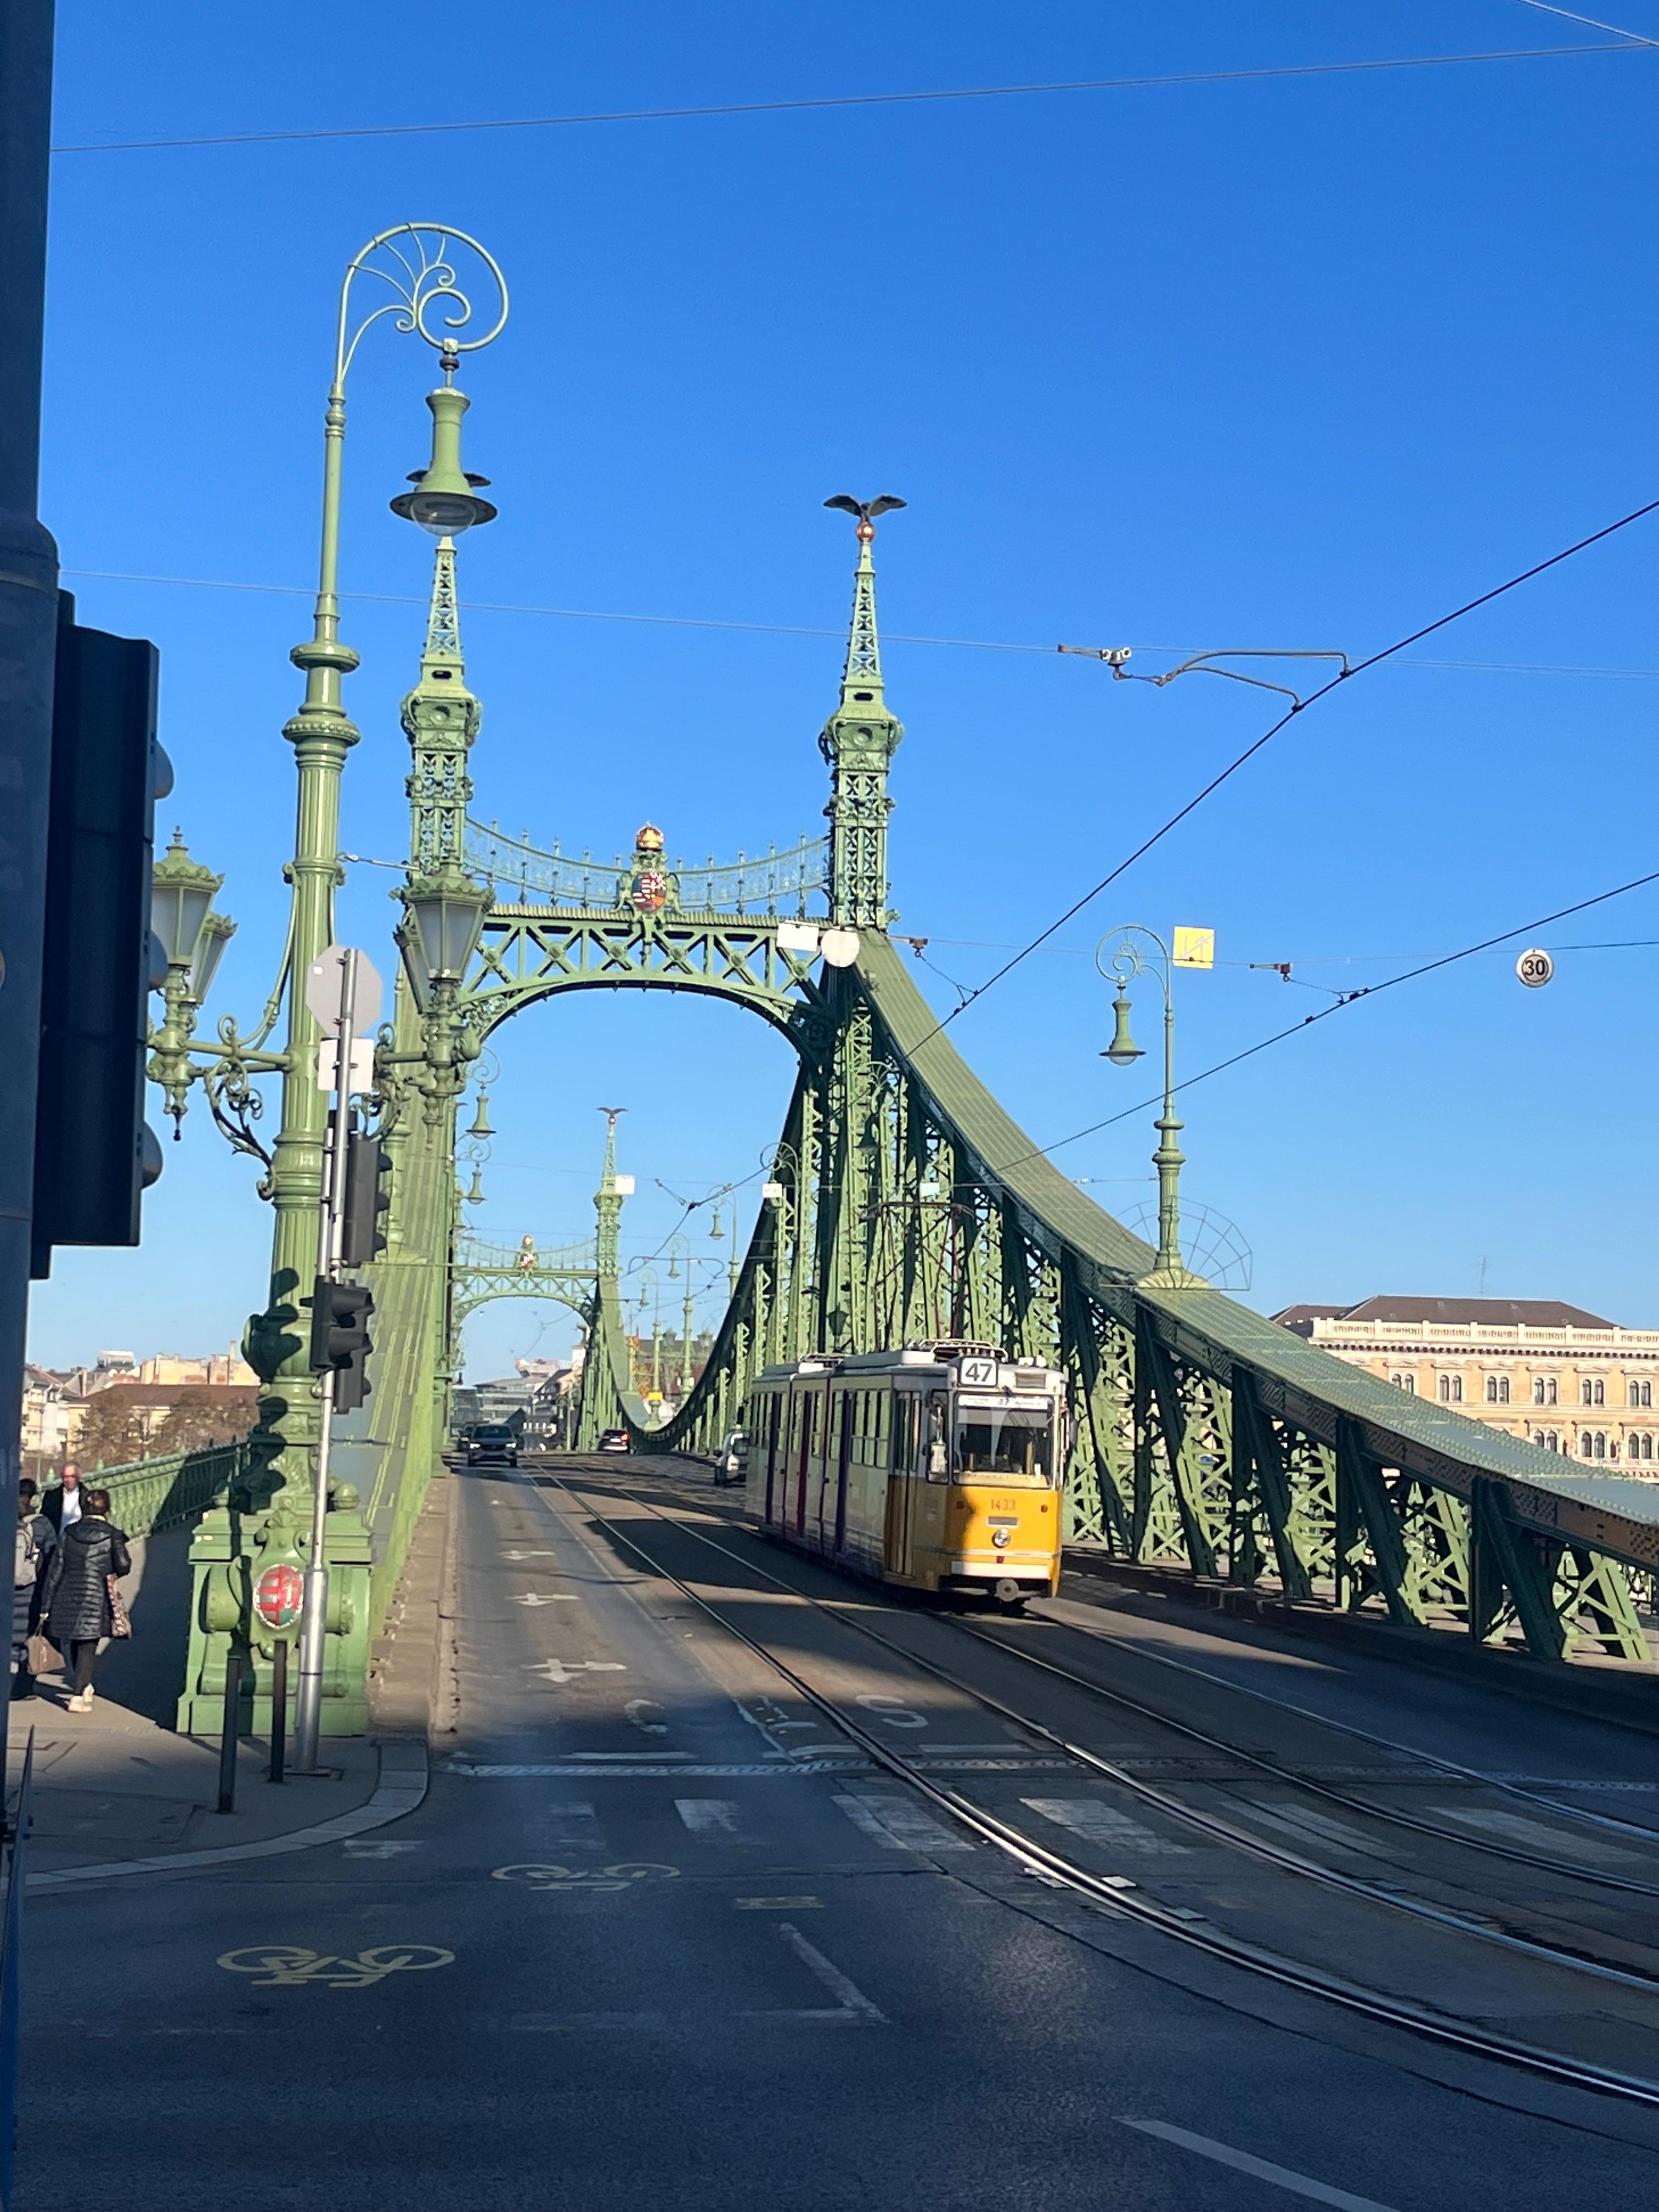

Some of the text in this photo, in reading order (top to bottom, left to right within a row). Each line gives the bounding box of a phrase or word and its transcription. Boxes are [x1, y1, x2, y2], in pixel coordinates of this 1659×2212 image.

[1524, 960, 1545, 976] 30
[965, 1363, 993, 1382] 47
[990, 1499, 1016, 1511] 1433
